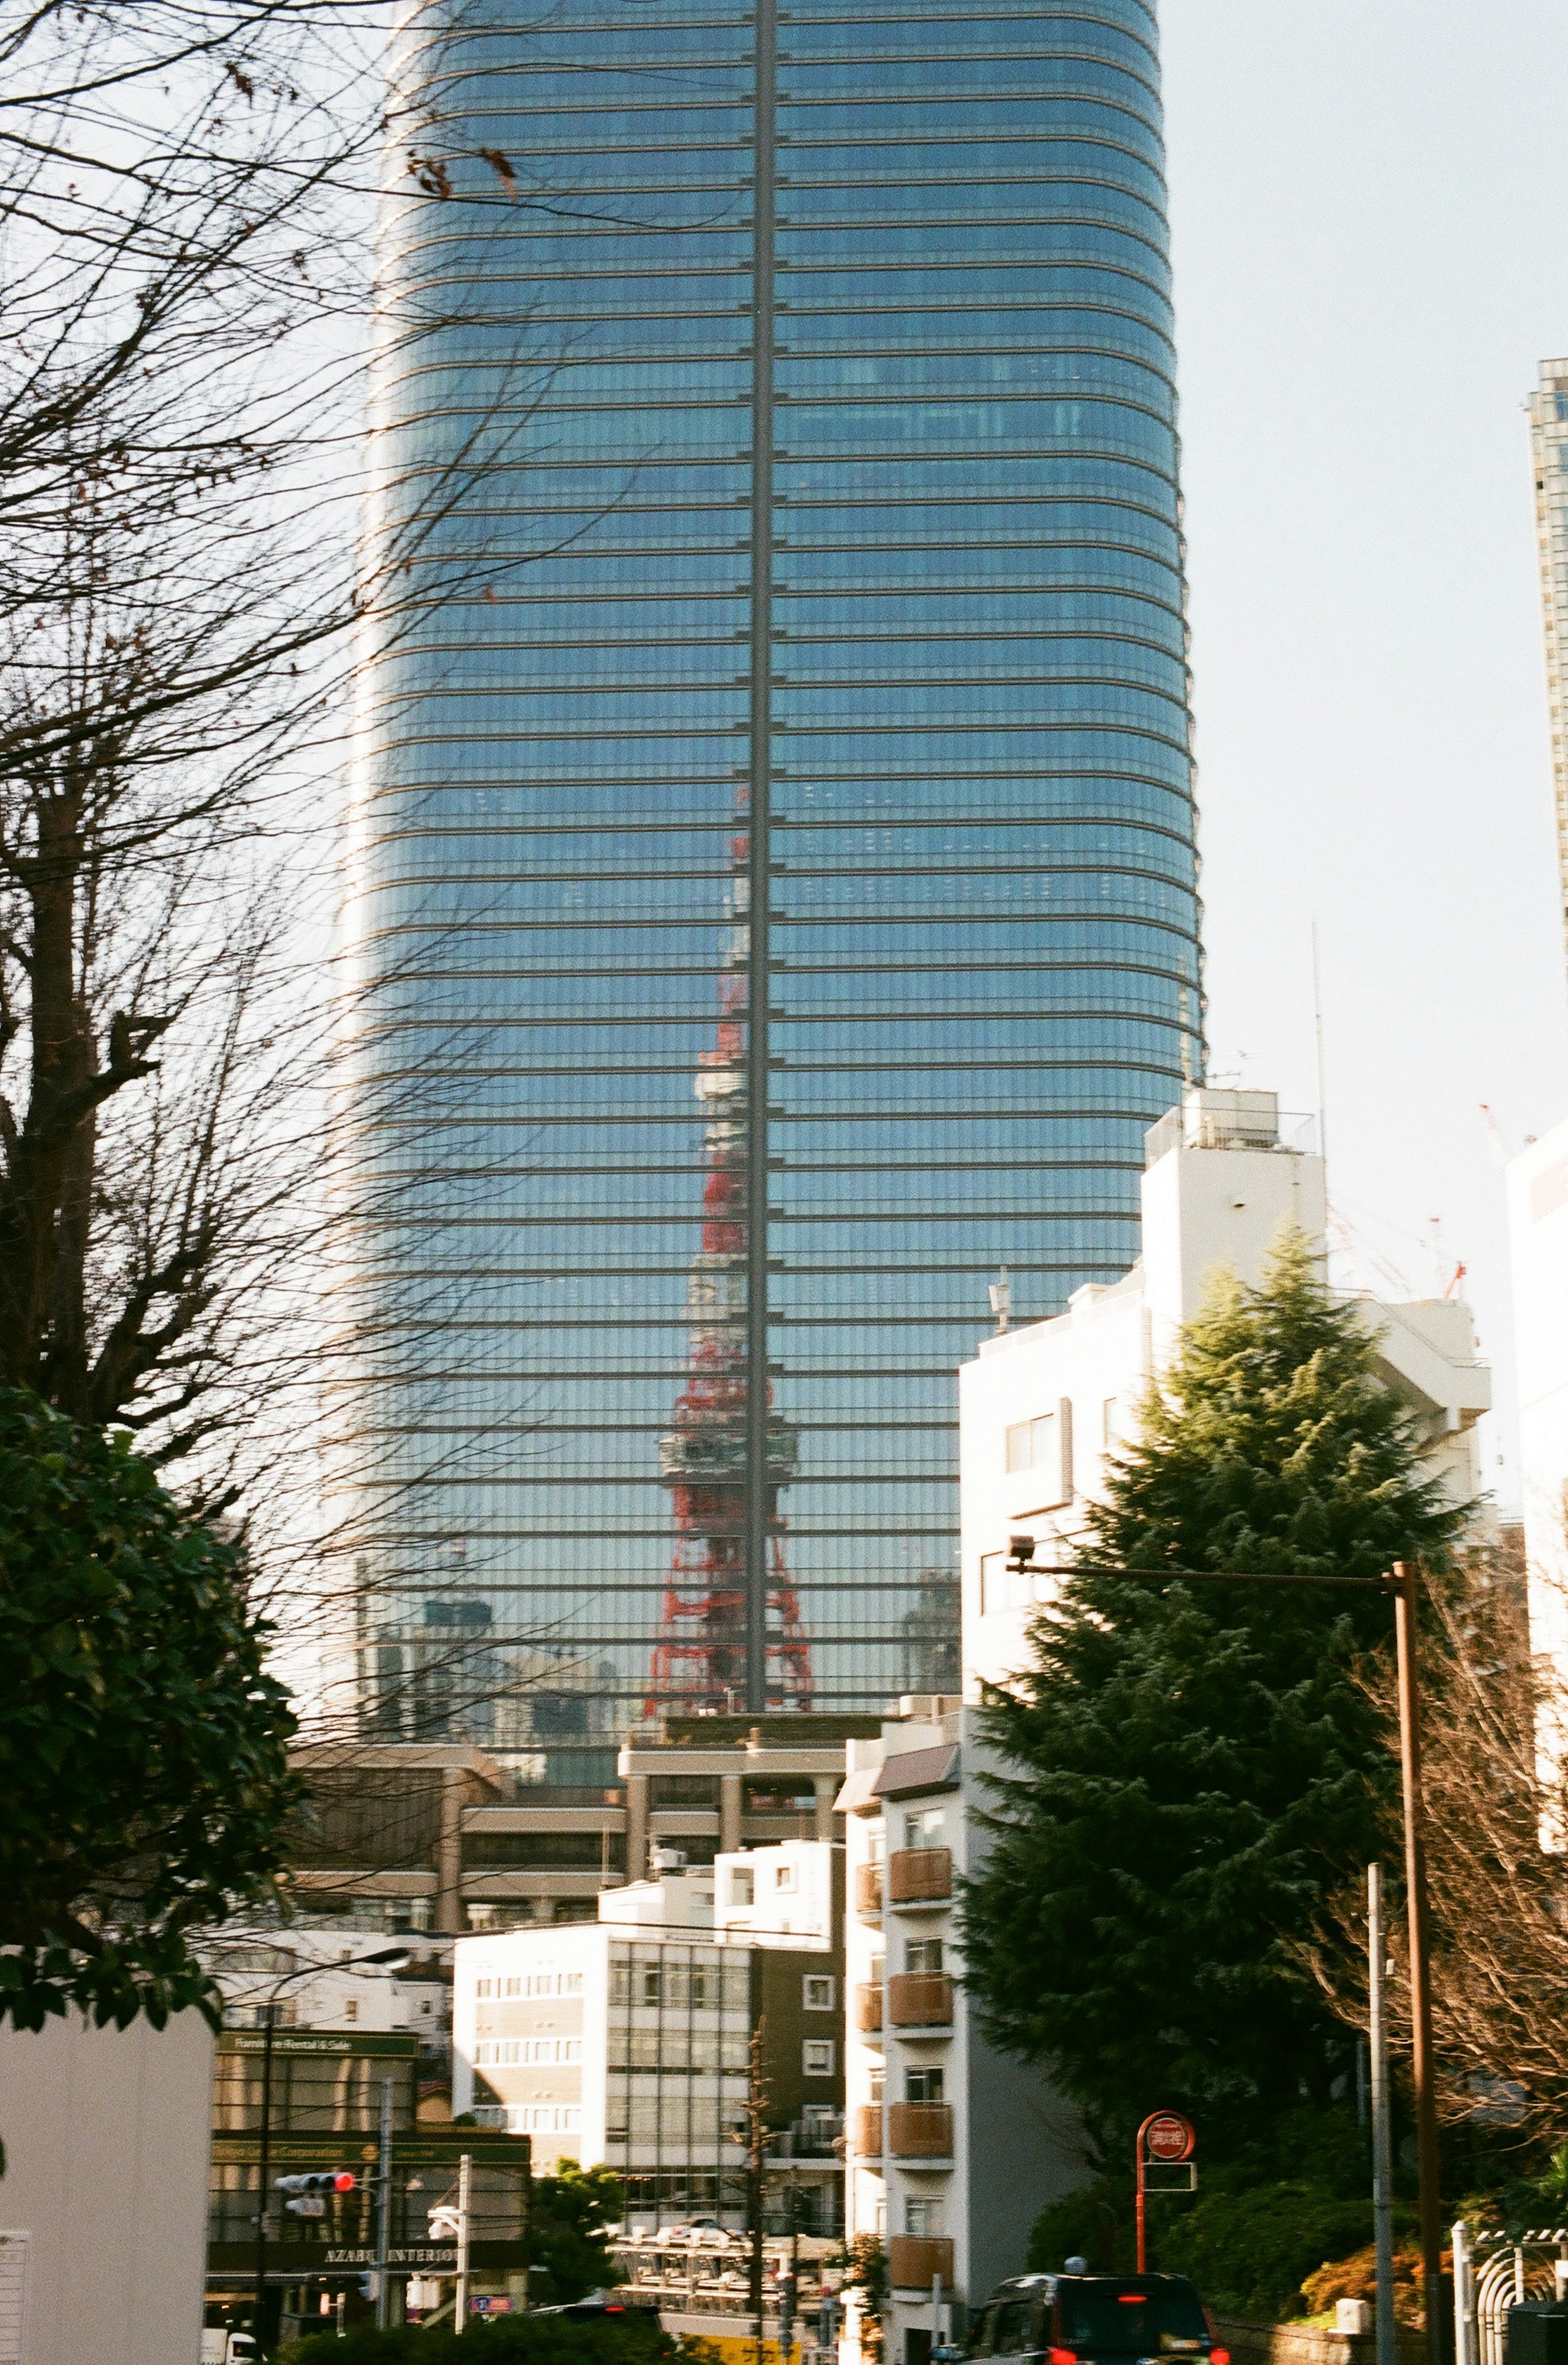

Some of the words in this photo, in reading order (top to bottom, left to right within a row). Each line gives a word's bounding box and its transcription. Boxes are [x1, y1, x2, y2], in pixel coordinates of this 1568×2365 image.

[235, 2038, 283, 2048] Furnitre
[284, 2039, 316, 2049] Rental
[318, 2040, 326, 2049] &
[327, 2040, 352, 2050] Sale
[279, 2146, 344, 2158] Corporation
